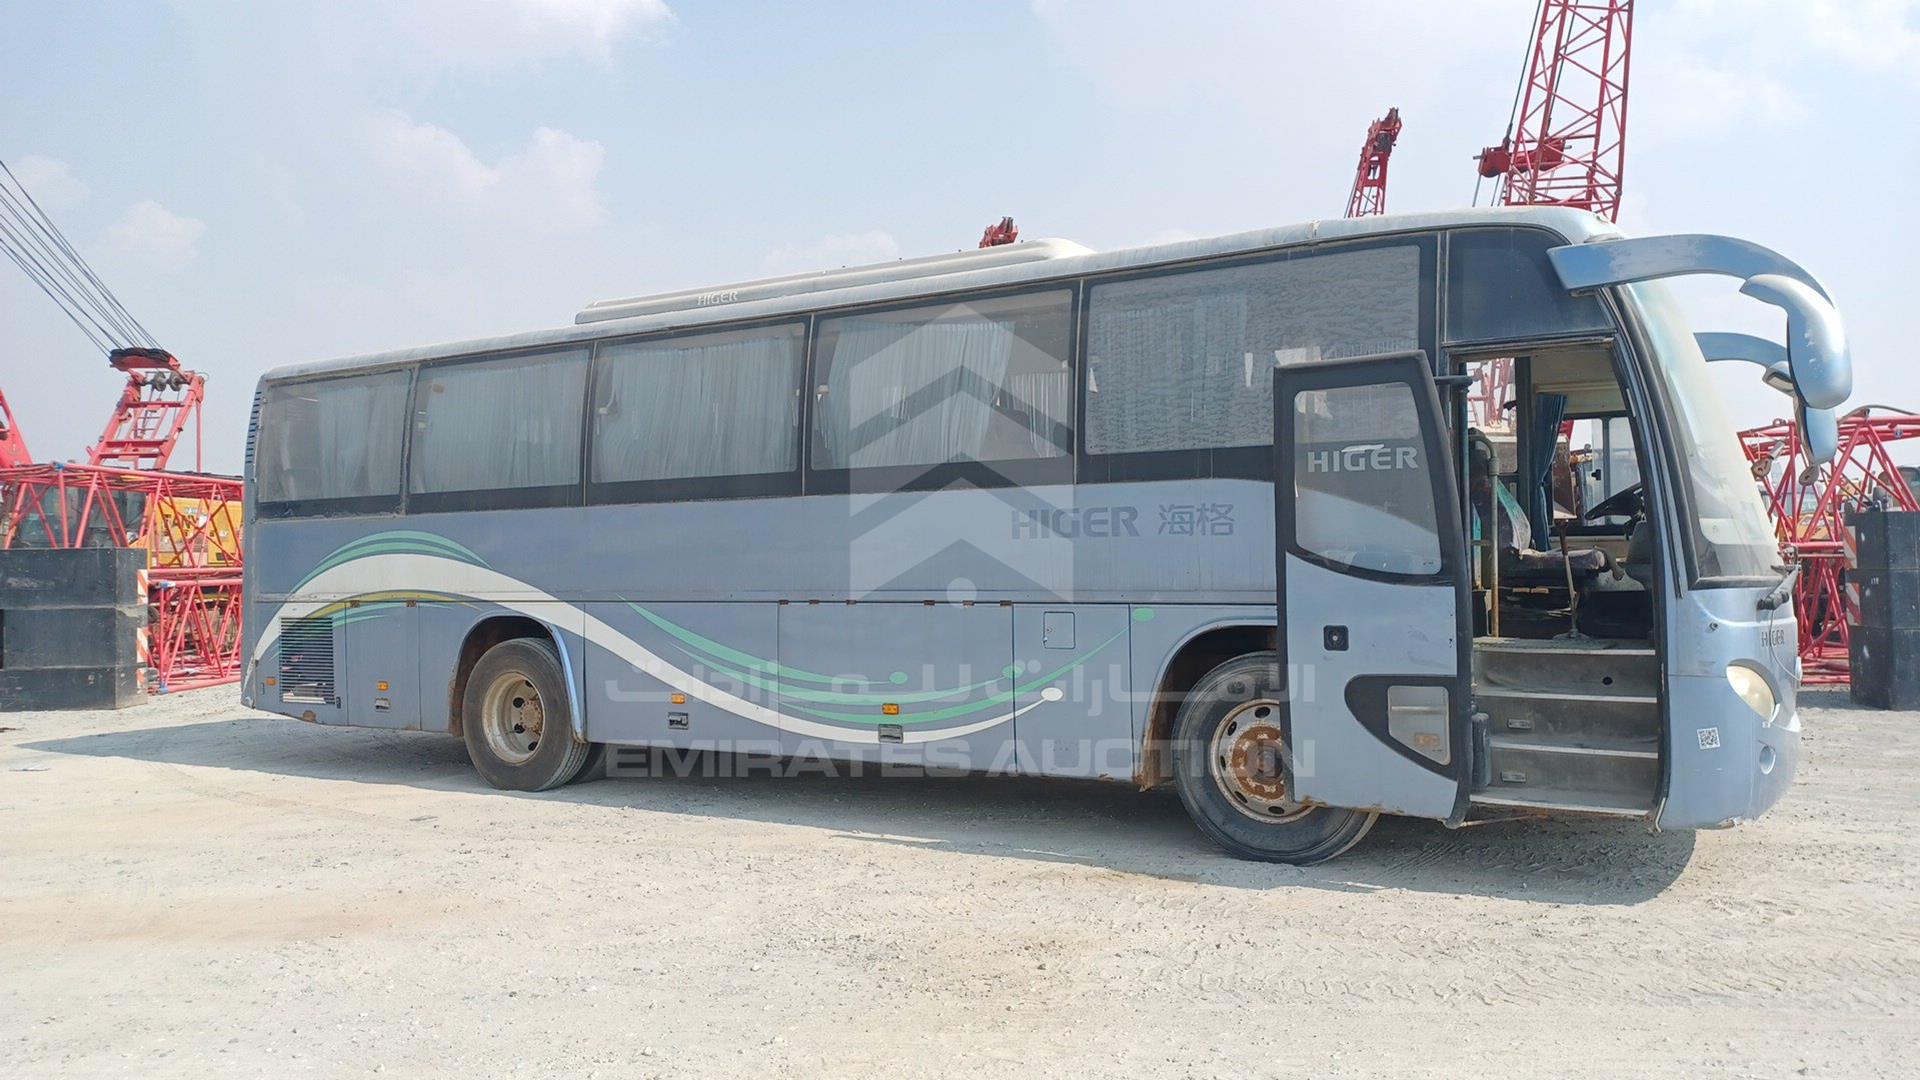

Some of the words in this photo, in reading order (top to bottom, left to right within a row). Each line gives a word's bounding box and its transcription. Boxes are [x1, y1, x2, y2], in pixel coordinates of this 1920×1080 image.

[697, 290, 738, 306] HIGER
[1306, 447, 1419, 472] HIGER
[1011, 505, 1139, 539] HIGER
[1158, 503, 1235, 536] 海格
